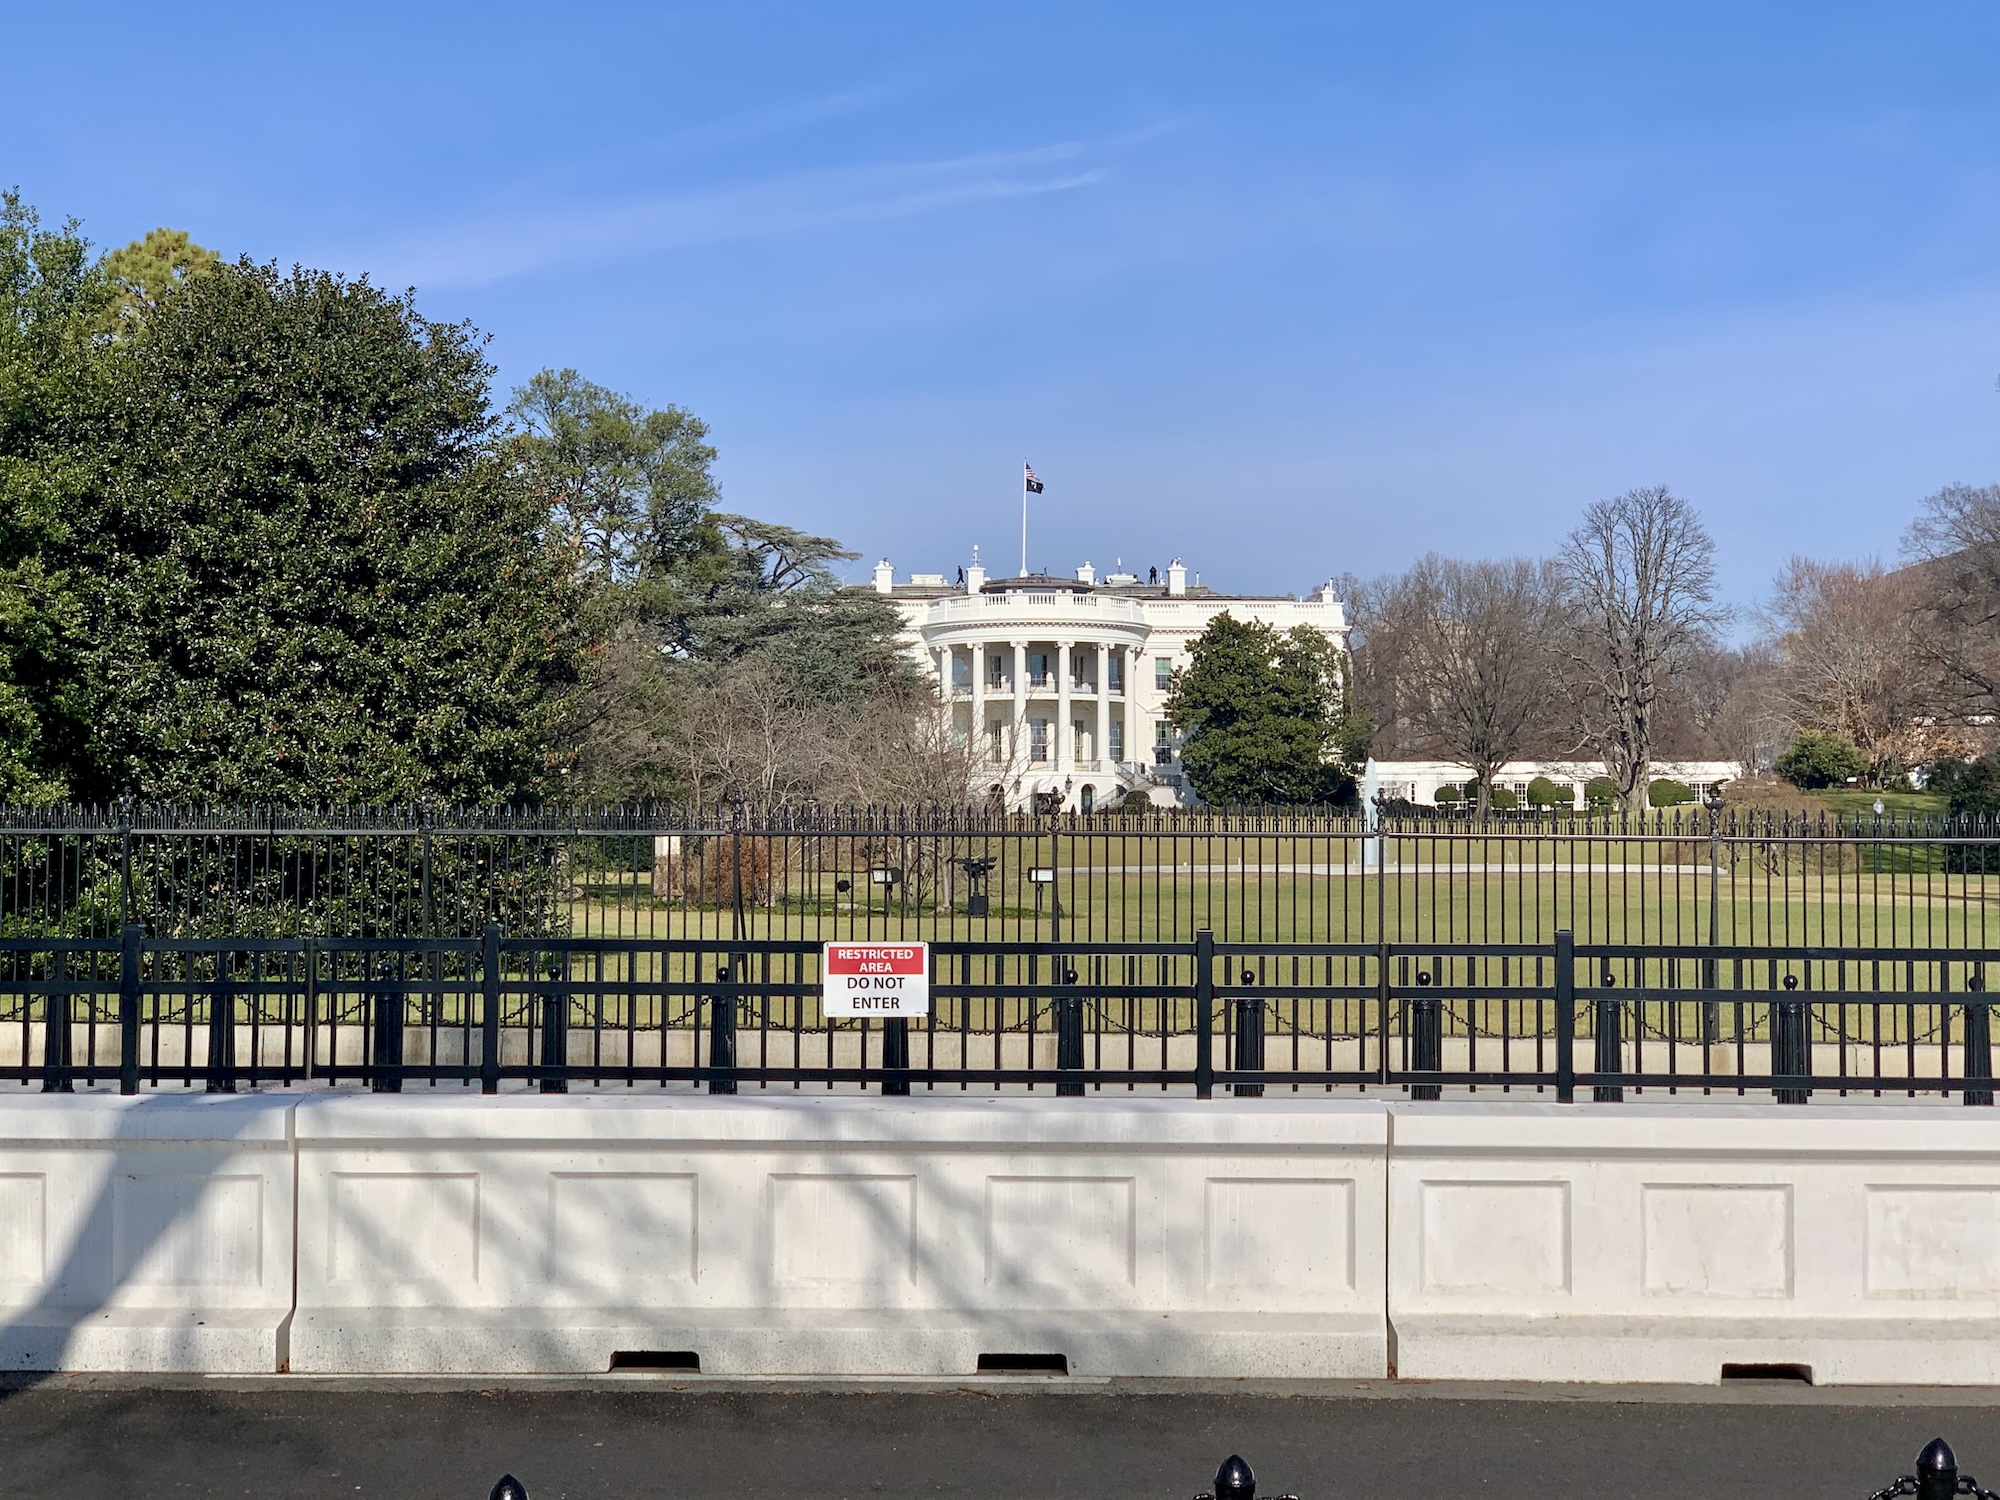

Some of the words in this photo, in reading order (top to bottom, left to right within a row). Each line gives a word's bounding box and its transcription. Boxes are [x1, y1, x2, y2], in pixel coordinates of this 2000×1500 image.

[838, 949, 914, 960] RESTRICTED
[859, 962, 893, 972] AREA
[847, 977, 869, 989] DO
[874, 977, 905, 989] NOT
[853, 997, 900, 1009] ENTER
